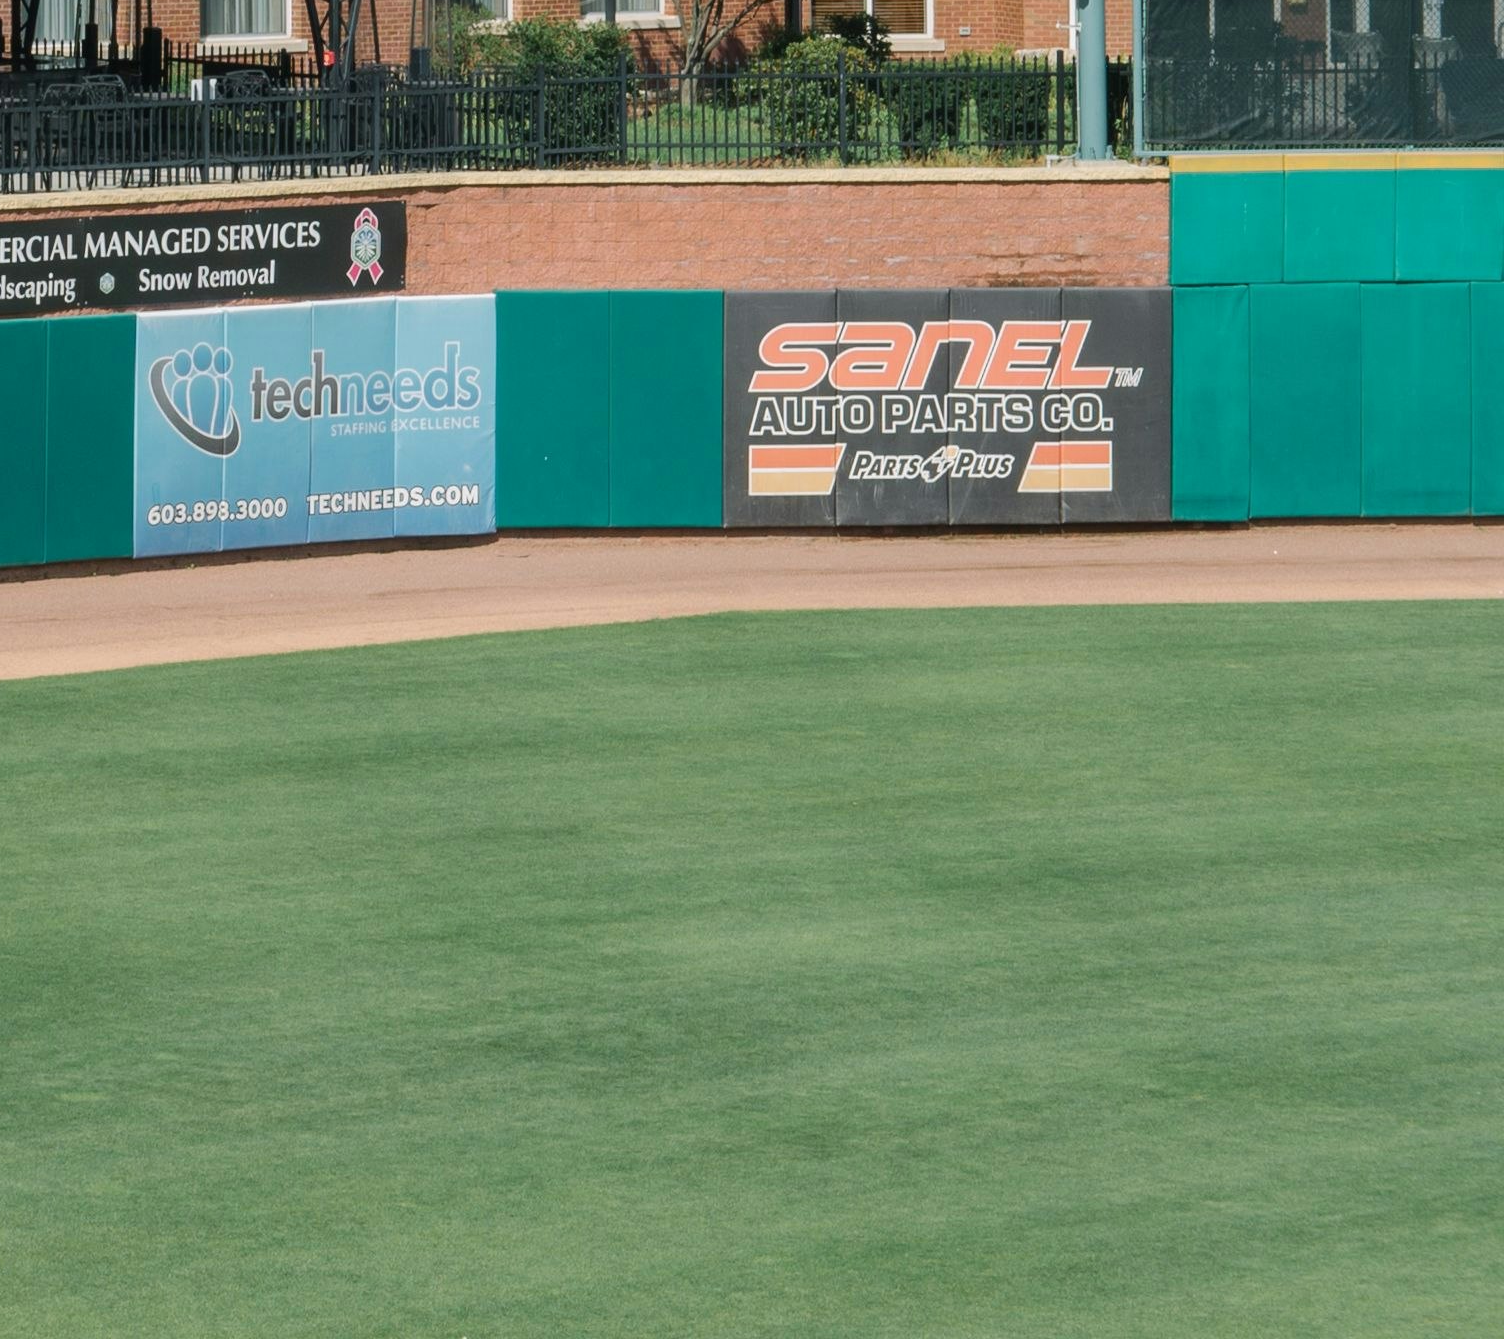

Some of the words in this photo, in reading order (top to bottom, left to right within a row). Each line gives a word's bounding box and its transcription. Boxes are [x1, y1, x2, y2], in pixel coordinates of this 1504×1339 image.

[84, 227, 211, 259] MANAGED
[217, 220, 321, 253] SERVICES
[138, 267, 193, 293] Snow
[197, 260, 277, 289] Removal
[249, 341, 482, 422] techneeds
[331, 420, 386, 437] STAFFING
[391, 416, 481, 433] EXCELLENCE
[749, 395, 875, 436] AUTO
[882, 393, 1033, 434] PARTS
[1041, 393, 1114, 433] CO.
[147, 497, 288, 526] 603.898.3000
[306, 483, 480, 516] TECHNEEDS.COM
